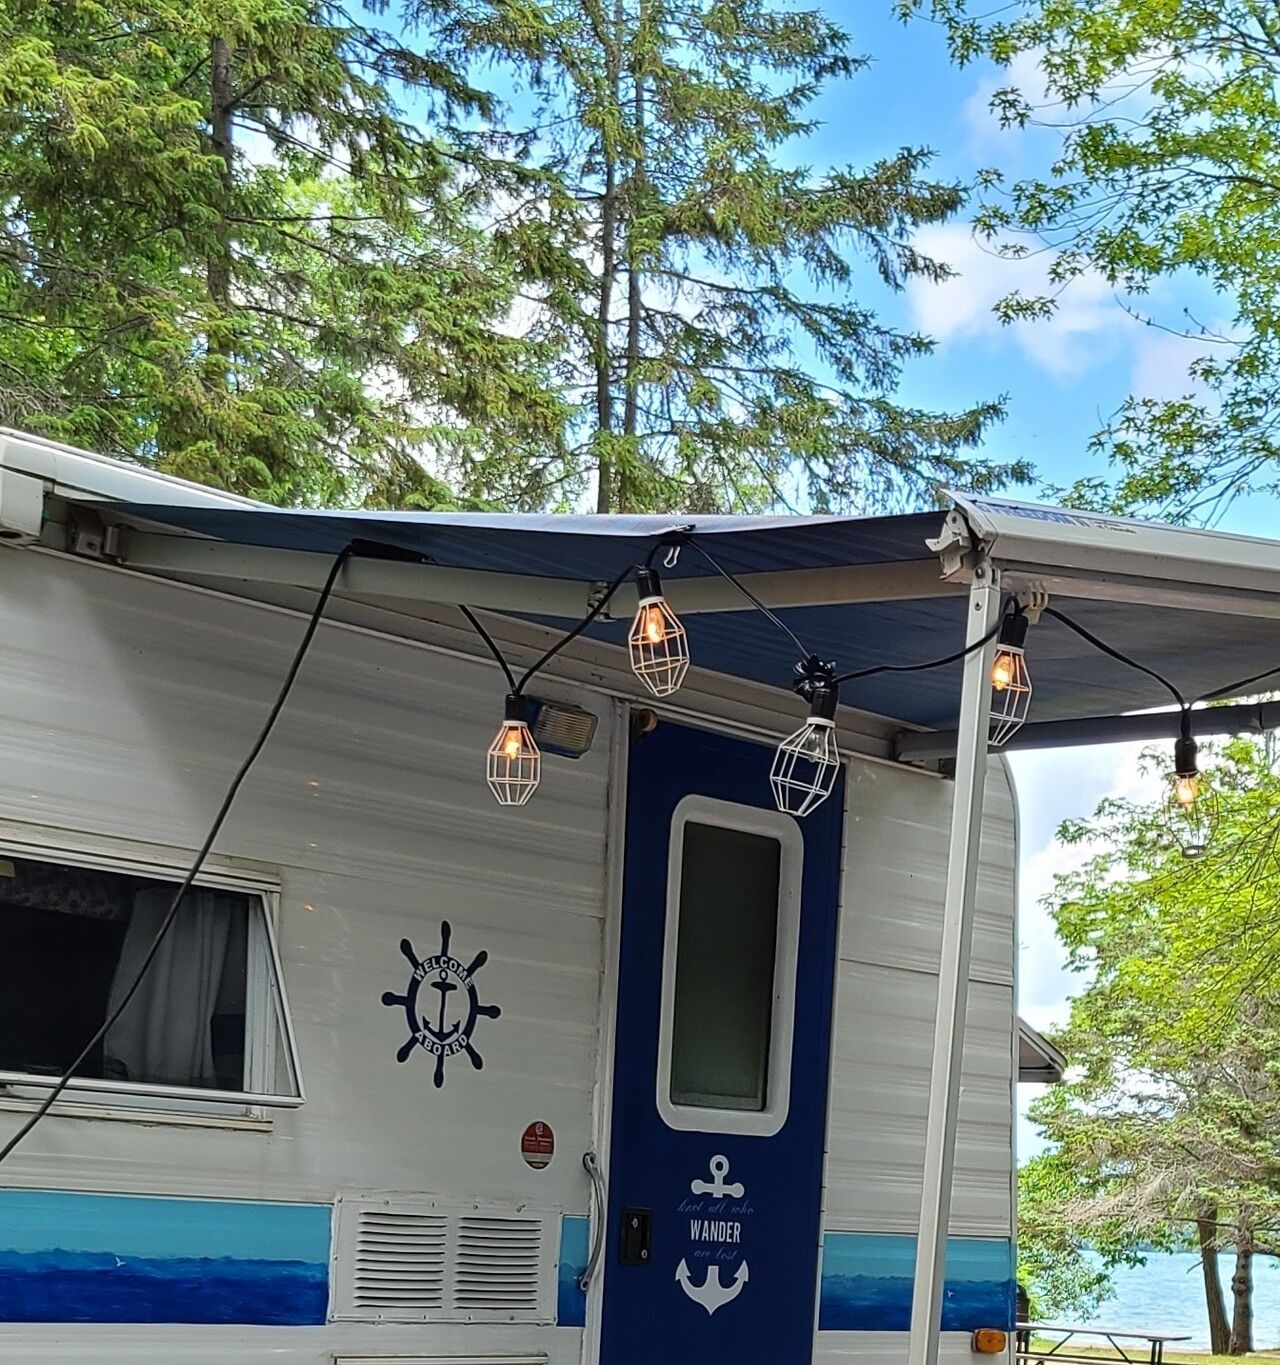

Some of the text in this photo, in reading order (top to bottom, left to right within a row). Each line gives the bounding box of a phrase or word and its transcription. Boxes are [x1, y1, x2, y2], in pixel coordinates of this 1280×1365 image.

[413, 956, 474, 990] WELCOME
[414, 1031, 469, 1057] ABOARD
[708, 1199, 728, 1213] all
[731, 1199, 754, 1215] who
[690, 1218, 742, 1244] WANDER
